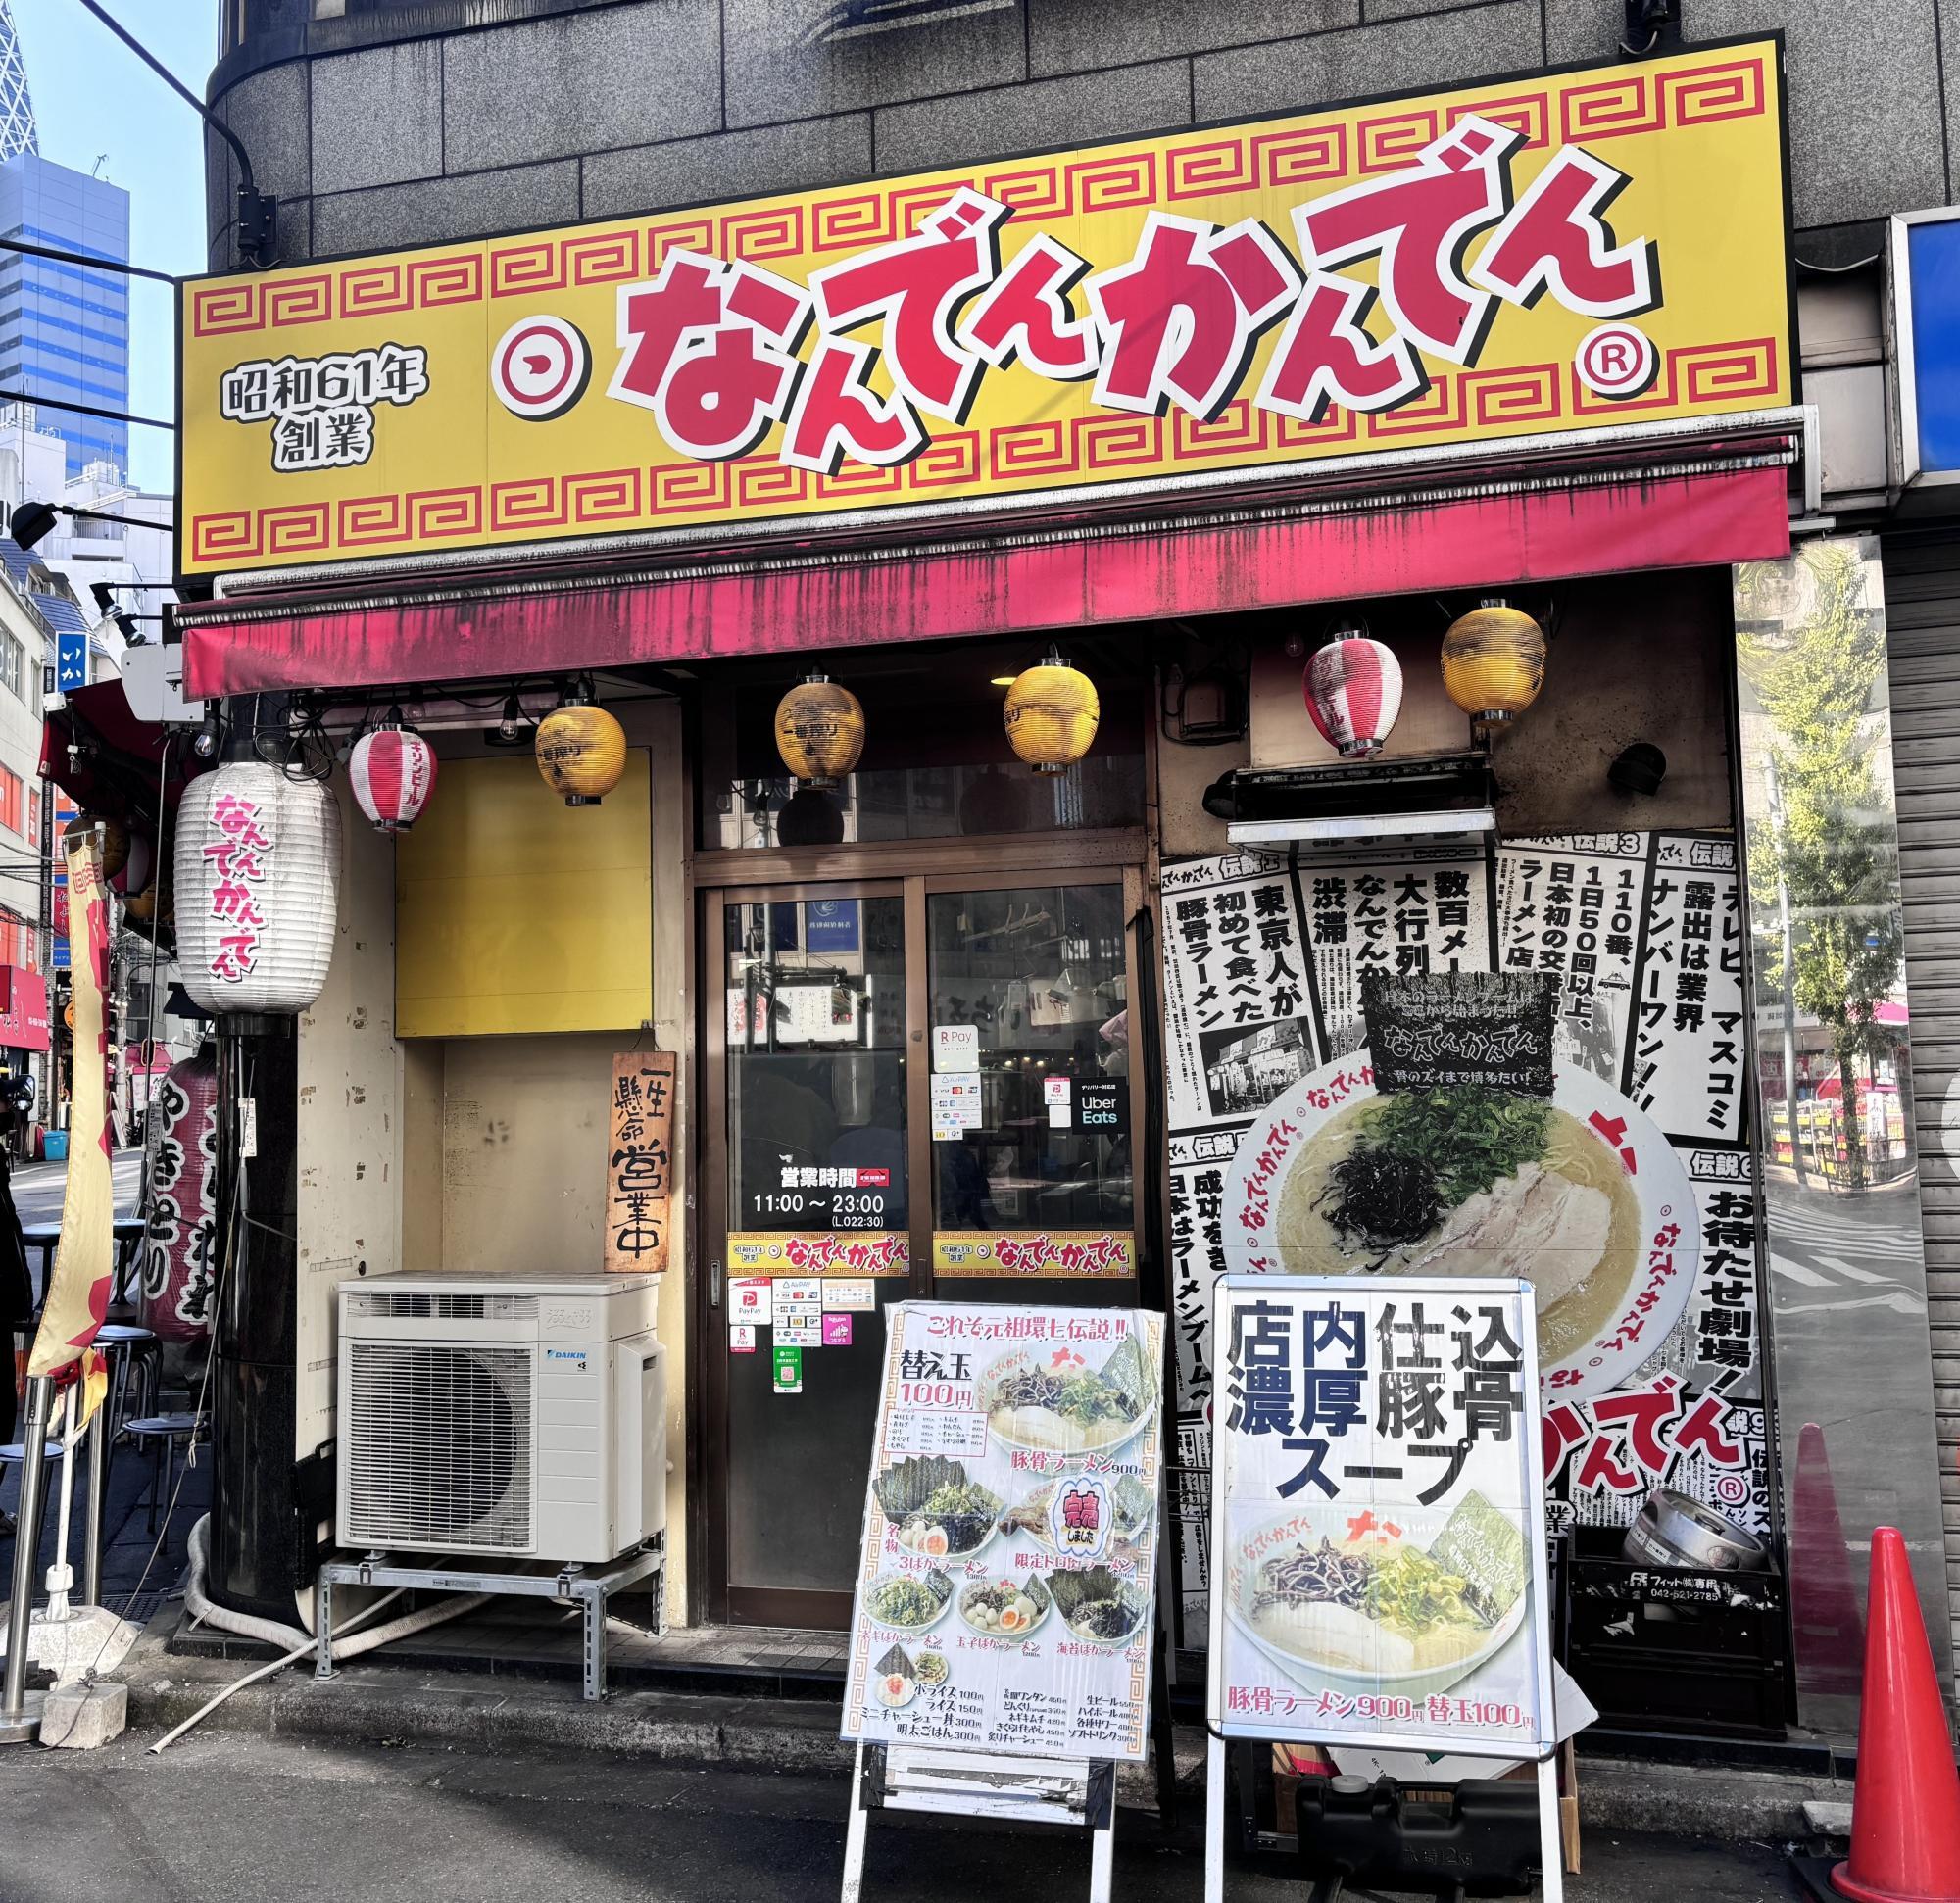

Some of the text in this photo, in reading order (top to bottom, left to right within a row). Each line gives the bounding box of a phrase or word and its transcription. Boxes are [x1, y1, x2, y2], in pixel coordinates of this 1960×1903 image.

[617, 114, 1656, 474] なんでんかんでん
[223, 347, 425, 417] 昭和61年
[277, 415, 371, 466] 創業
[202, 793, 272, 983] なんでんかんでん
[1312, 877, 1349, 946] 渋滞
[1394, 874, 1430, 977] 大行列
[1505, 859, 1543, 968] ラーメン店
[1175, 896, 1224, 1028] 豚骨ラーメン
[1212, 891, 1265, 1023] 初めて食べた
[1251, 885, 1303, 1017] 東京人が
[1673, 881, 1716, 1033] 露出は業界
[951, 1031, 972, 1044] Pay
[1384, 1023, 1537, 1063] なんでんかんでん
[641, 1068, 672, 1118] 一生
[1081, 1097, 1116, 1111] Uber
[1082, 1111, 1117, 1125] Eats
[781, 1167, 857, 1188] 営業時間
[612, 1139, 667, 1259] 営業中
[754, 1194, 804, 1212] 11:00
[833, 1195, 884, 1213] 23:00
[785, 1234, 909, 1271] なんでんかんでん
[994, 1235, 1128, 1272] なんでんかんでん
[1226, 1299, 1524, 1373] 店内仕込
[900, 1349, 973, 1382] 替え玉
[901, 1383, 973, 1409] 100円
[1225, 1366, 1524, 1441] 濃厚豚骨
[1011, 1450, 1114, 1473] 豚骨ラーメン
[1275, 1437, 1473, 1507] スープ
[885, 1523, 900, 1553] 名物
[1068, 1531, 1094, 1544] しました
[899, 1556, 988, 1574] 3ばかラーメン
[956, 1635, 1041, 1652] 玉子ばかラーメン
[914, 1683, 957, 1698] 小ライス
[926, 1698, 957, 1712] ライス
[897, 1724, 954, 1739] 明太ごはん
